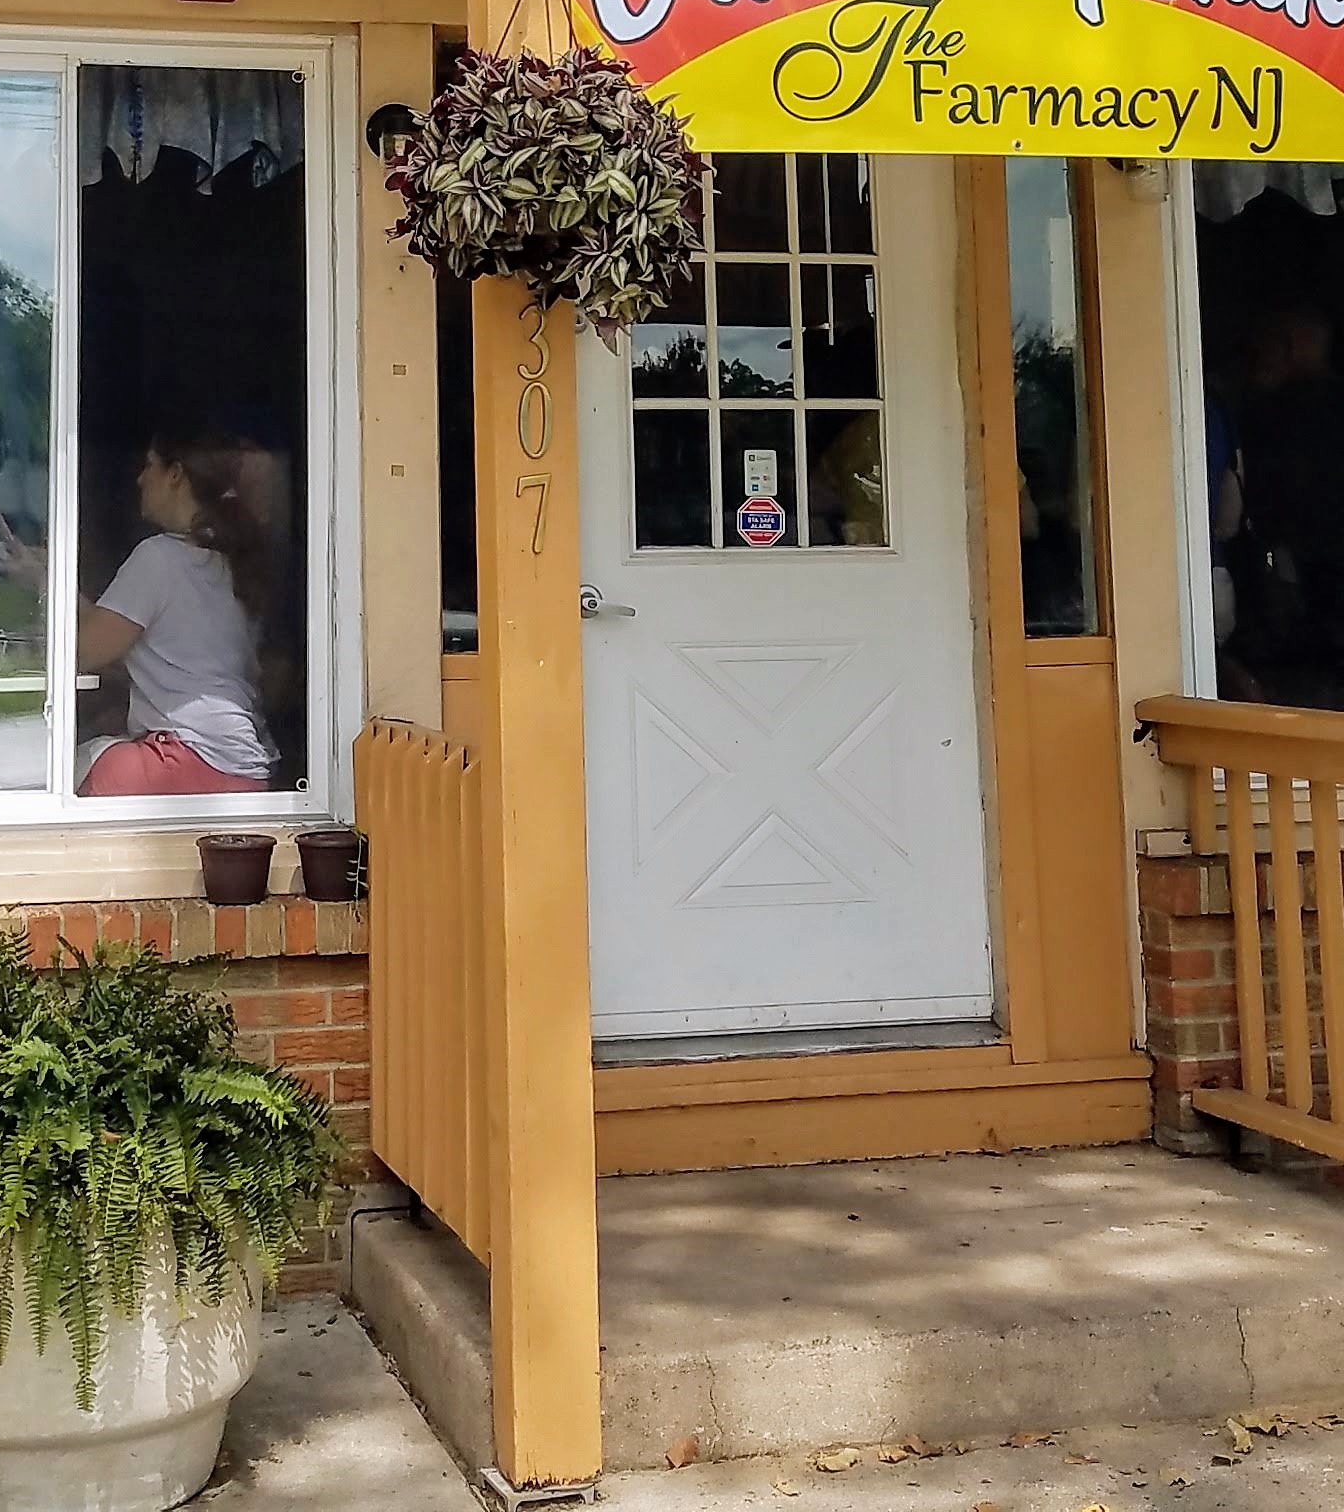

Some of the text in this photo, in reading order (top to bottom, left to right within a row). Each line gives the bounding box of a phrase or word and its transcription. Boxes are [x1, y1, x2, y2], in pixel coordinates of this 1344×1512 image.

[905, 60, 1284, 155] Farmacy NJ
[517, 303, 552, 555] 307
